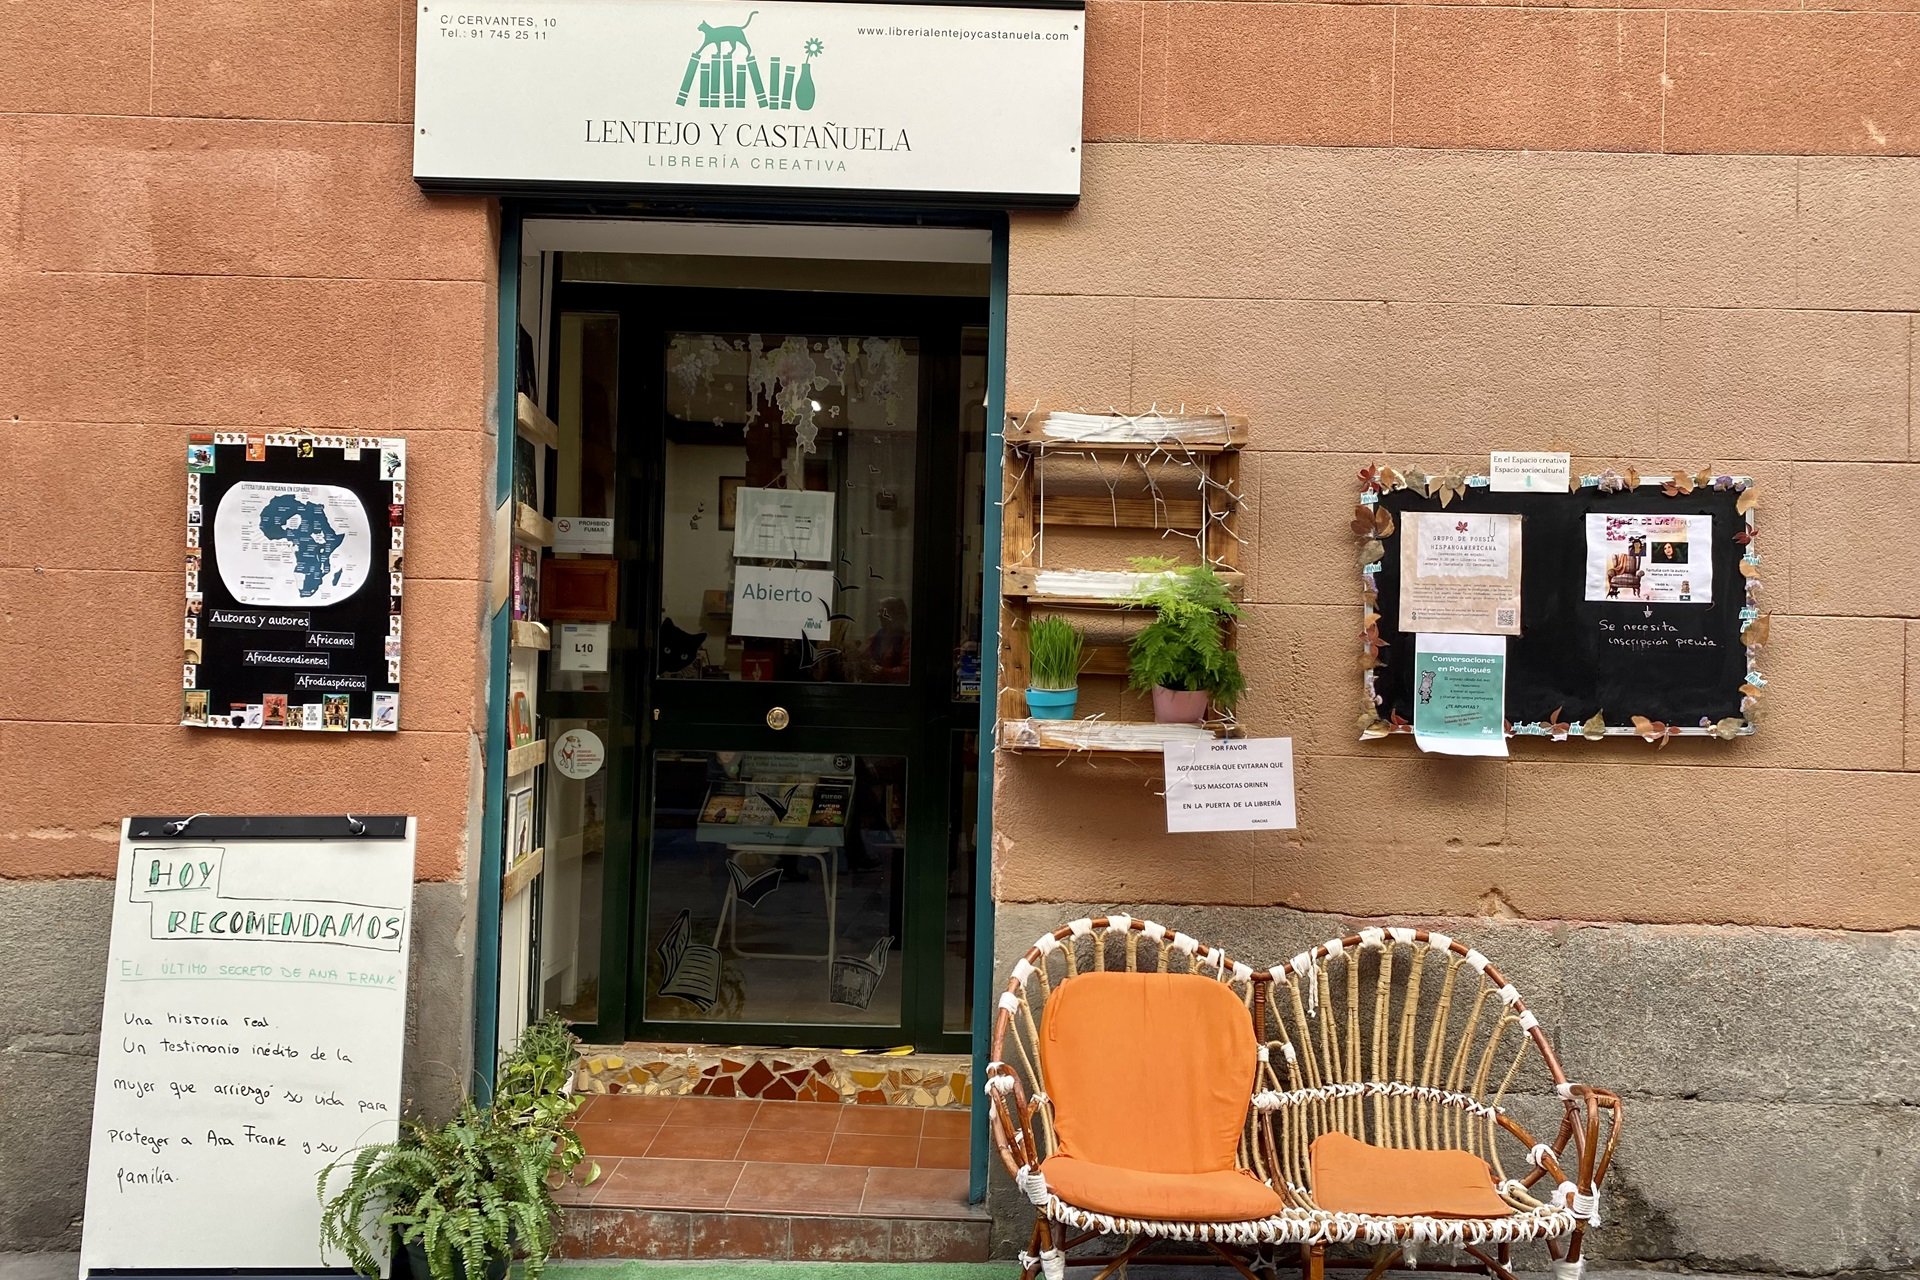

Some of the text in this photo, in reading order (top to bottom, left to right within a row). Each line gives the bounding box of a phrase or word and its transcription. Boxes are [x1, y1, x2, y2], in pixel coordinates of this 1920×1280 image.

[440, 14, 557, 28] C/ CERVANTES, 10
[440, 28, 546, 40] Tel.: 91 745 25 11
[857, 26, 1069, 41] www.librerialentejoycastanuela.com
[584, 119, 912, 151] LENTEJO Y CASTAÑUELA
[648, 153, 846, 172] LIBRERÍA CREATIVA
[1512, 456, 1537, 464] Espacio
[742, 583, 812, 603] Abierto
[210, 610, 309, 628] Autoras y autores
[1598, 619, 1678, 632] Se necesita
[308, 634, 354, 647] Africanos
[575, 644, 594, 653] L10
[245, 652, 328, 666] Afrodescendientes
[1432, 656, 1496, 664] Conversaciones
[1450, 666, 1492, 674] Portugués
[296, 676, 366, 690] Afrodiaspóricos
[149, 859, 215, 888] HOY
[168, 910, 400, 940] RECOMENDAMOS
[161, 958, 208, 976] ÚLTIMO
[219, 964, 272, 977] SECRETO
[281, 966, 302, 978] DE
[308, 968, 338, 980] ANA
[124, 1012, 152, 1026] Una
[167, 1012, 229, 1026] historia
[122, 1036, 352, 1063] Un testimonio inédito de la
[114, 1078, 388, 1114] mujer que arriesgó su vida para
[180, 1136, 192, 1146] a
[207, 1129, 234, 1147] Ana
[242, 1124, 287, 1147] Frank
[302, 1140, 311, 1154] y
[316, 1142, 338, 1154] su
[117, 1166, 179, 1194] familia.
